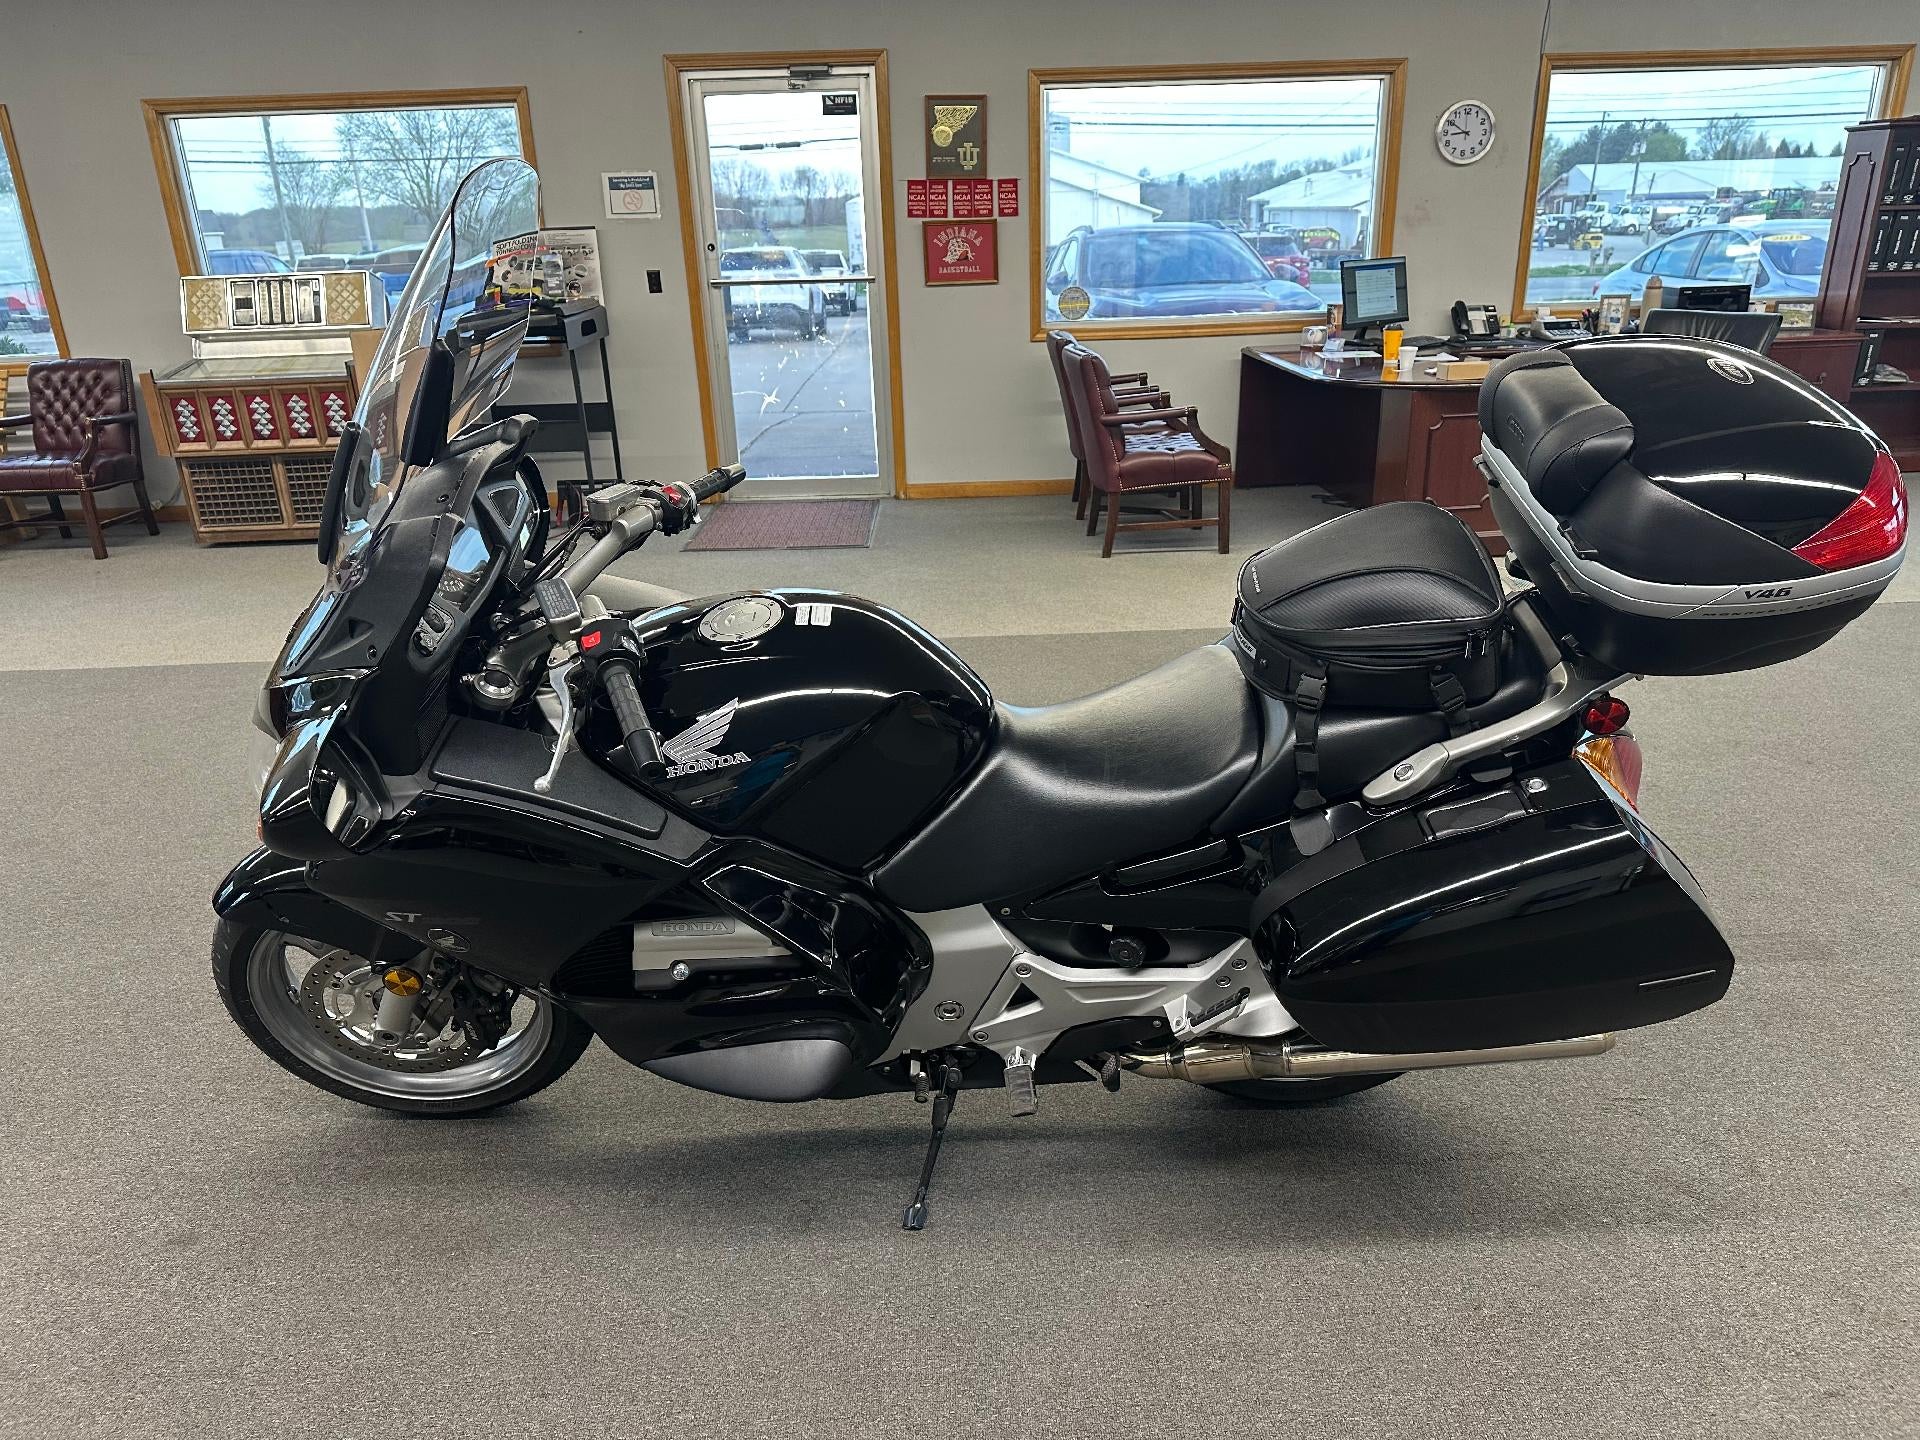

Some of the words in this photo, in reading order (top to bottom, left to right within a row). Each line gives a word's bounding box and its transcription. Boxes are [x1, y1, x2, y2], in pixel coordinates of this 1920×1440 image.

[1454, 110, 1460, 118] 11
[933, 226, 983, 247] INDIANA
[939, 265, 981, 273] BASKETBALL
[1744, 587, 1792, 599] V46
[666, 752, 751, 778] HONDA
[384, 912, 422, 922] ST
[662, 922, 728, 932] HONDA
